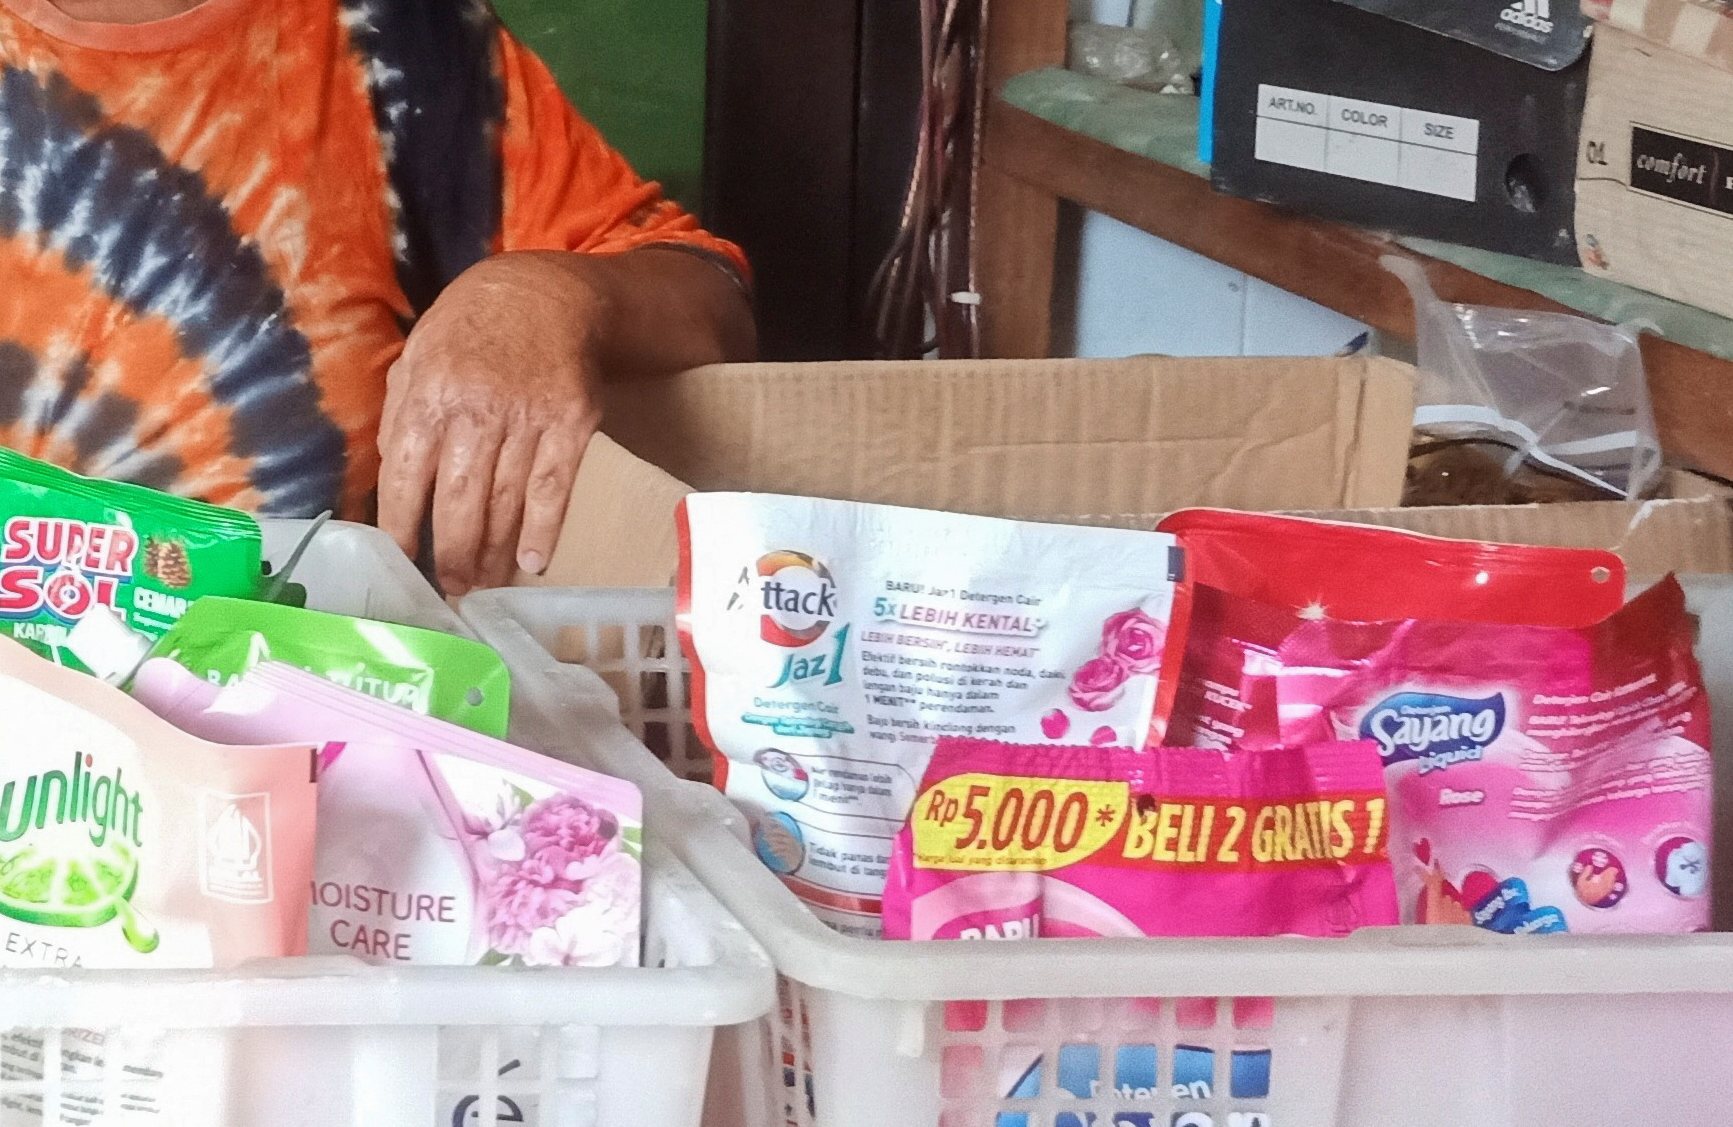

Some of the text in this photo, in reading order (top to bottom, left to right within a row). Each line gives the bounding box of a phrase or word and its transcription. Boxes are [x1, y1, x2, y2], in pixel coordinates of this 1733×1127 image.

[1500, 8, 1554, 33] adidas
[1341, 108, 1388, 128] COLOR
[1424, 122, 1454, 140] SIZE
[1636, 152, 1707, 184] comfort
[1, 518, 138, 575] SUPER
[873, 596, 898, 617] 5x
[899, 604, 958, 626] LEBIH
[959, 590, 1014, 606] Detergen
[1015, 594, 1042, 606] Cair
[860, 631, 991, 655] LEBIH LEBIH
[860, 650, 895, 664] Efektif
[898, 654, 936, 667] bersih
[892, 668, 912, 679] dan
[915, 672, 954, 685] polusi
[1005, 678, 1028, 689] dan
[1370, 708, 1496, 757] Sayang
[1418, 745, 1483, 775] Liquid
[1439, 788, 1484, 806] Rose
[1122, 802, 1215, 862] BELI
[1216, 806, 1247, 862] 2
[1251, 799, 1355, 862] GRATIS
[5, 931, 83, 968] EXTRA
[330, 919, 411, 960] CARE
